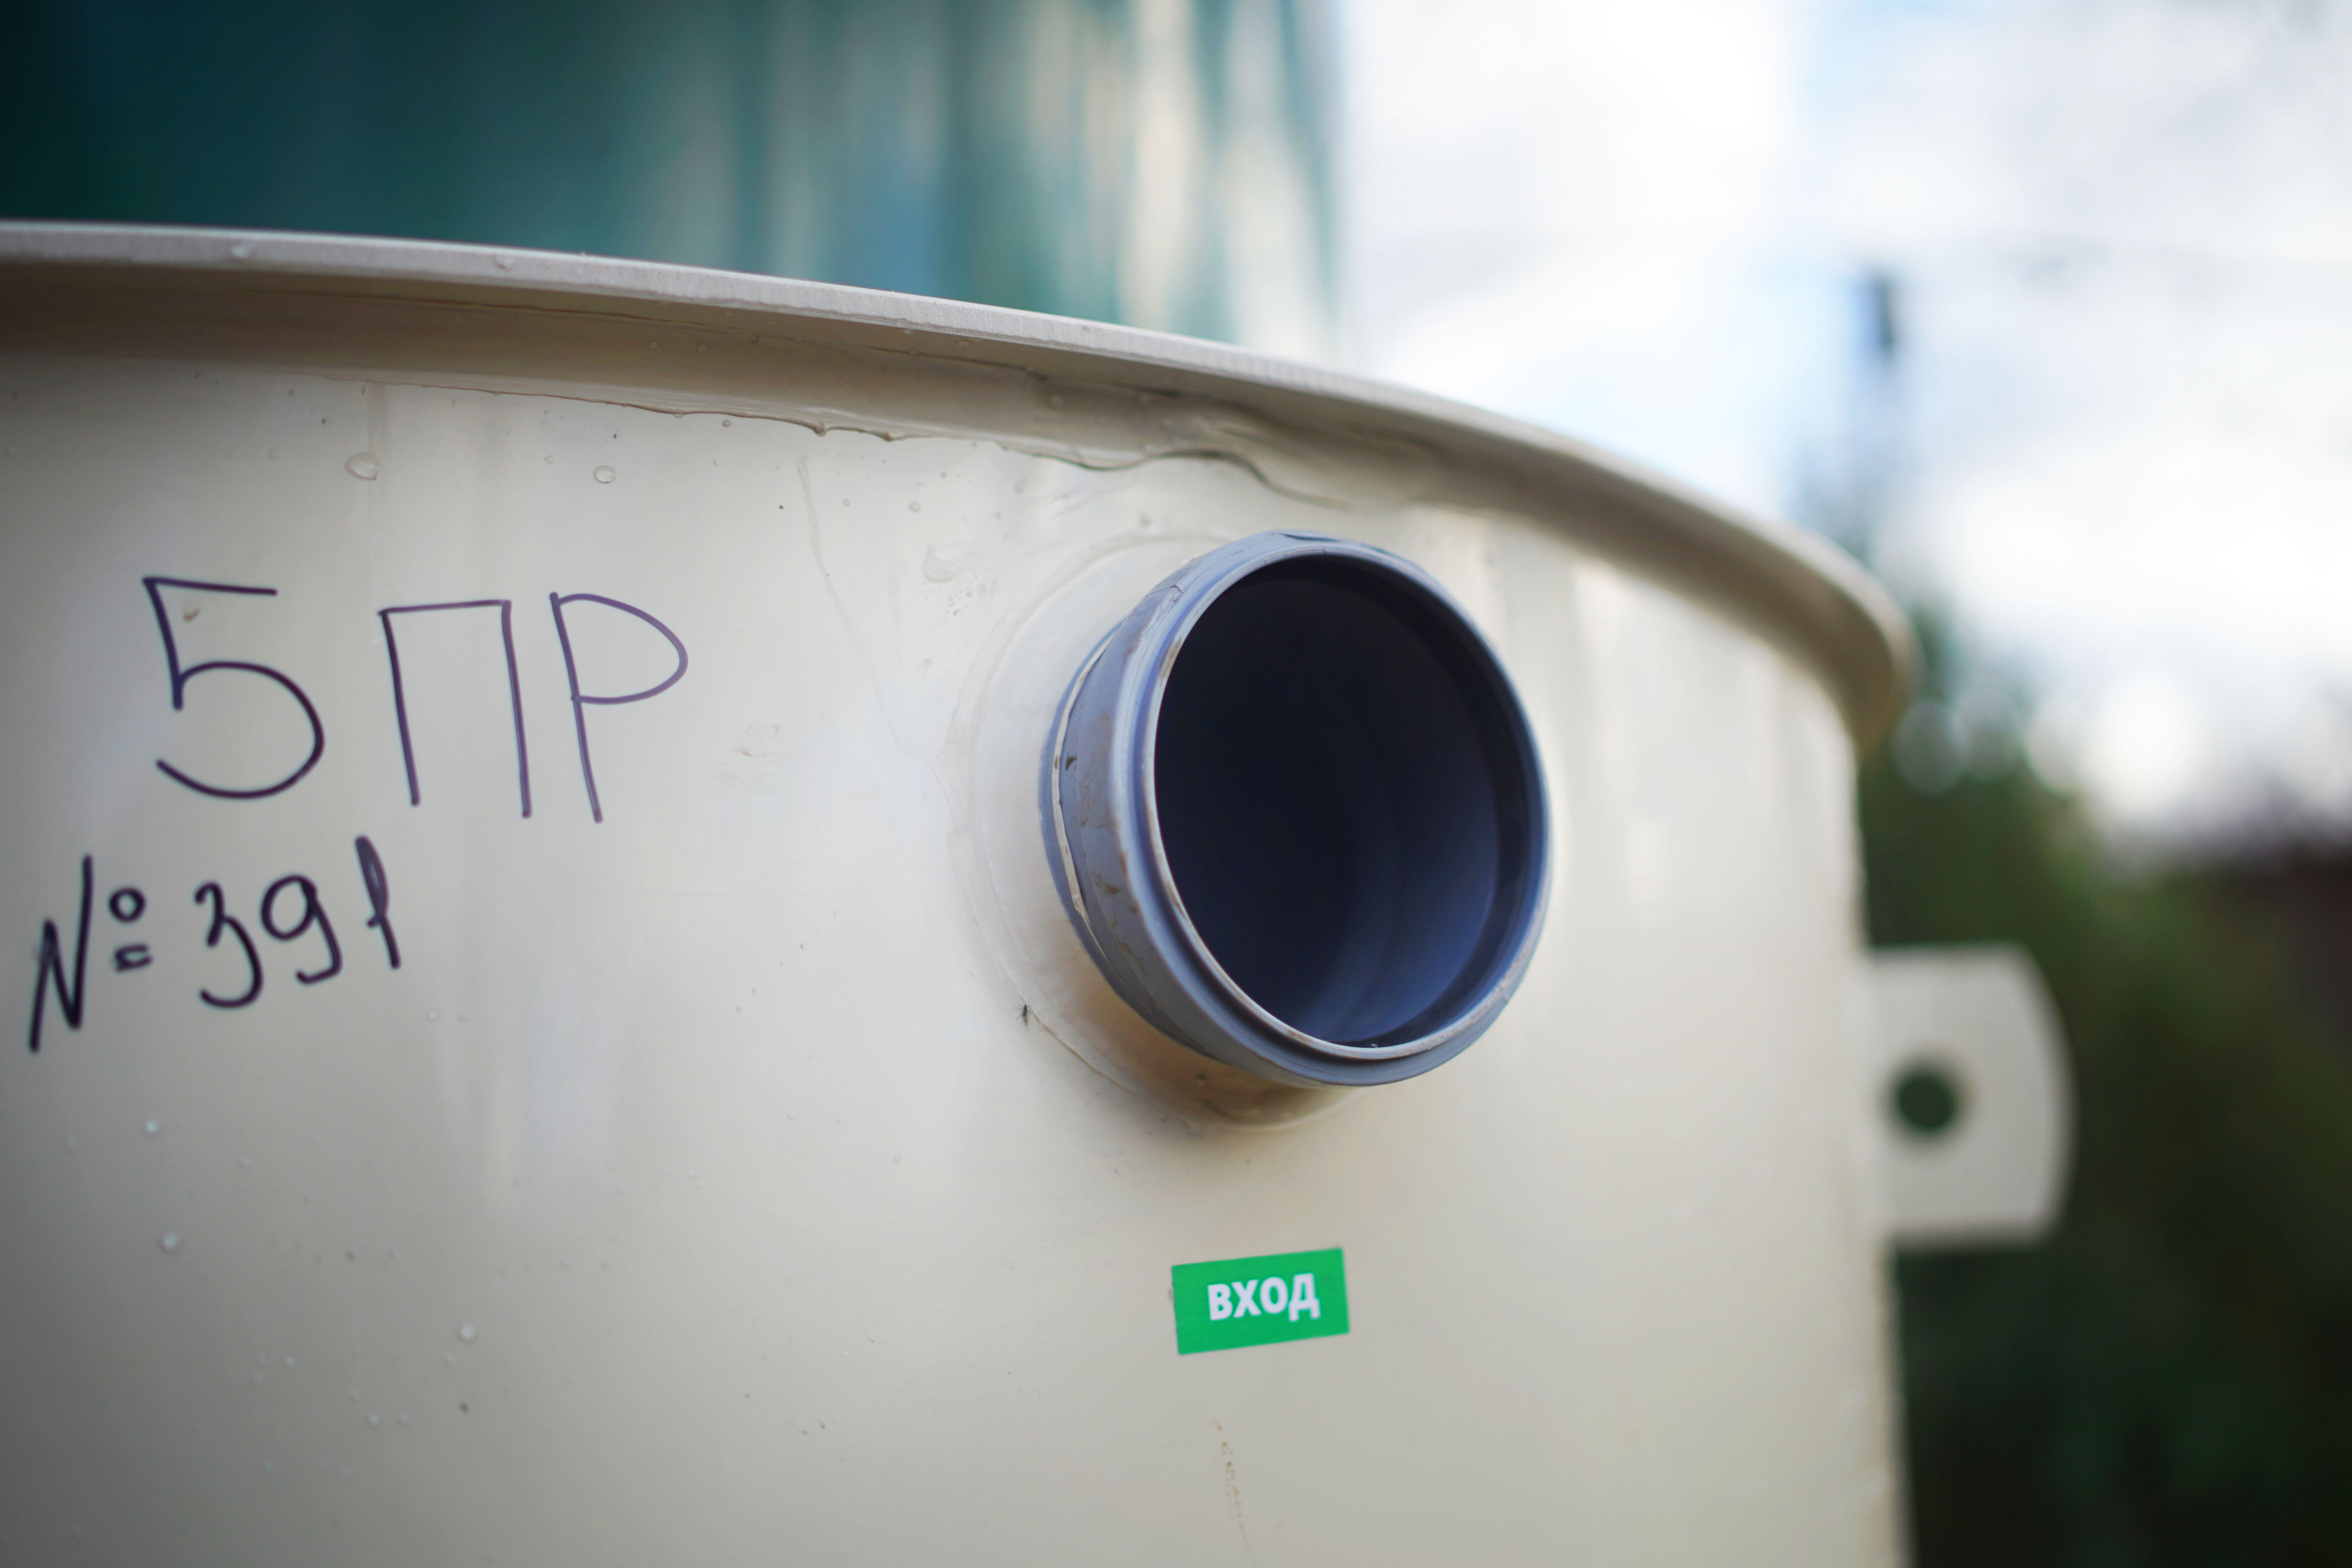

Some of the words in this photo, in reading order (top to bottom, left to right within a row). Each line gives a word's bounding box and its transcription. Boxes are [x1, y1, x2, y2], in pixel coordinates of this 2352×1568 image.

[142, 576, 325, 800] 5
[377, 591, 689, 824] ПР
[1207, 1272, 1320, 1322] ВХОД
